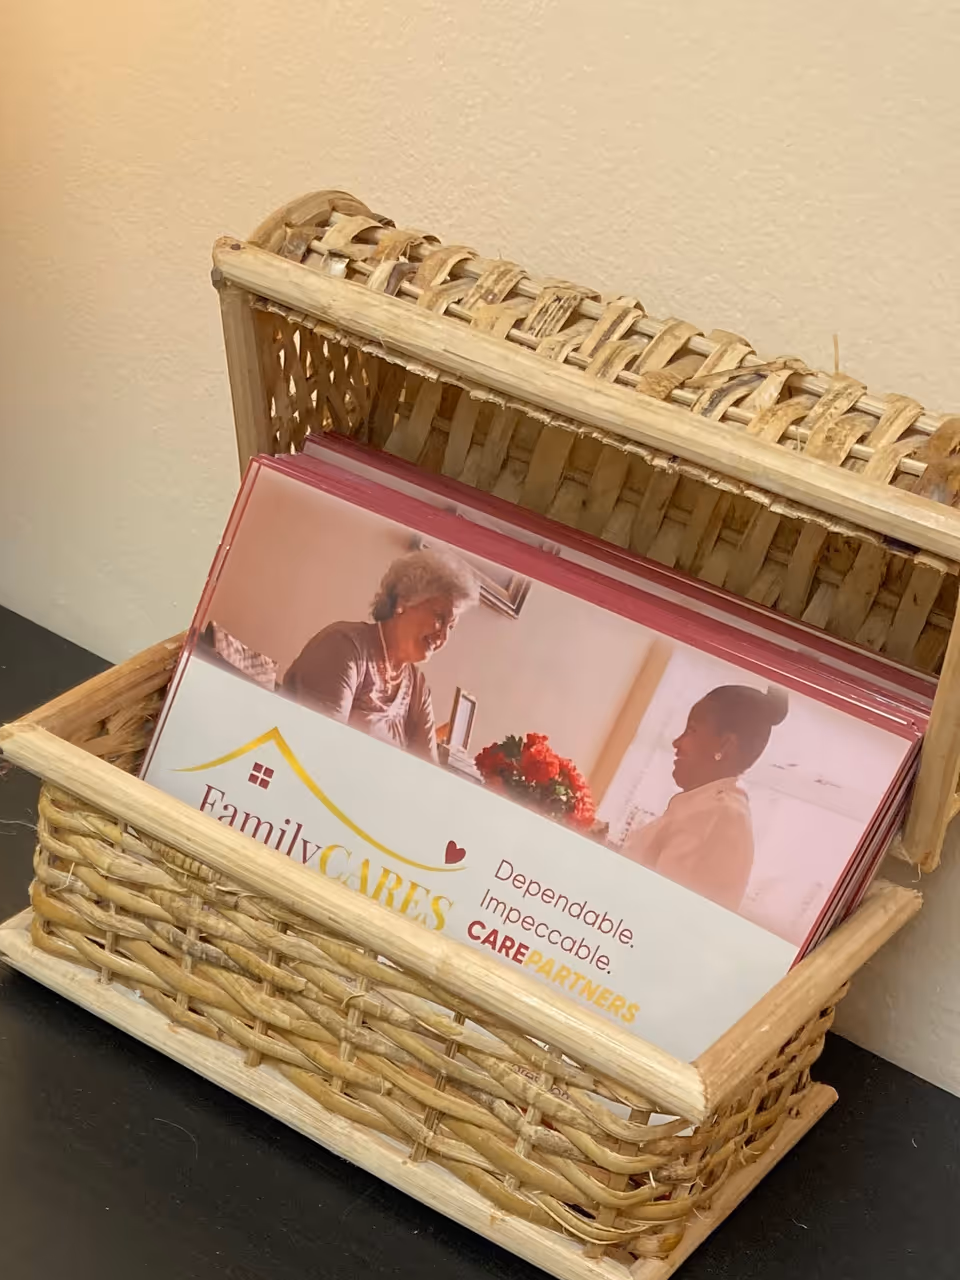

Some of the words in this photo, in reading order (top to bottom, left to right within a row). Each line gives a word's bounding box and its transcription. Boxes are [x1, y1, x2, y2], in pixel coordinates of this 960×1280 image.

[480, 890, 612, 974] Impeccable.
[494, 858, 635, 948] Dependable.
[467, 920, 640, 1025] CAREPARTNERS
